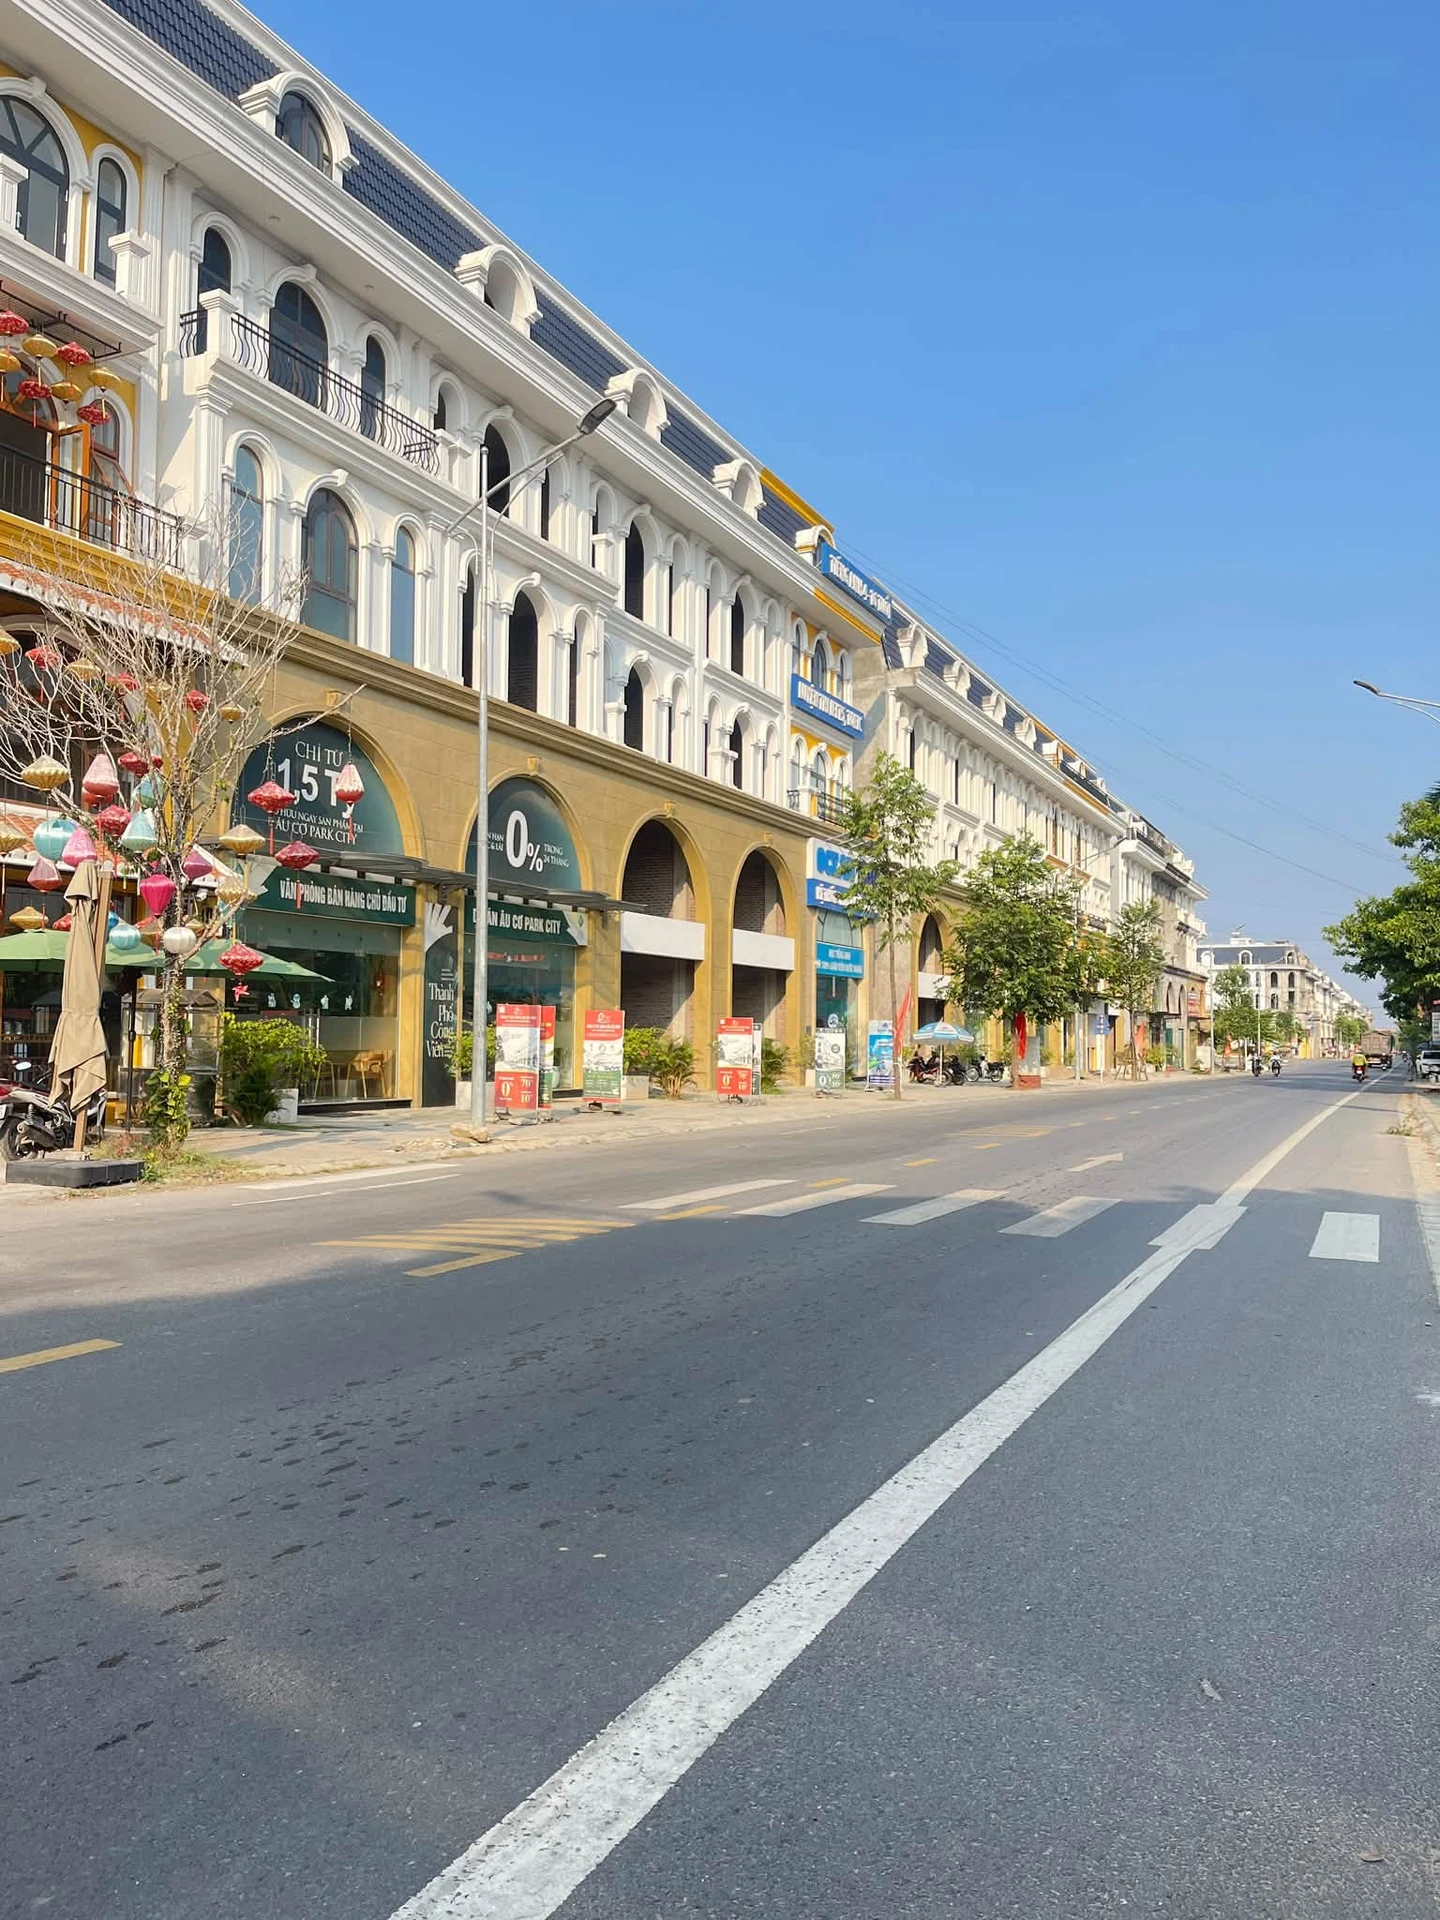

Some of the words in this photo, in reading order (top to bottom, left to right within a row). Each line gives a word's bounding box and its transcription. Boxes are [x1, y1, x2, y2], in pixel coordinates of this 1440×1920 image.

[309, 824, 334, 841] PARK
[506, 810, 544, 872] 0%
[524, 916, 545, 932] PARK
[545, 919, 561, 934] CITY
[428, 982, 454, 1001] Thành
